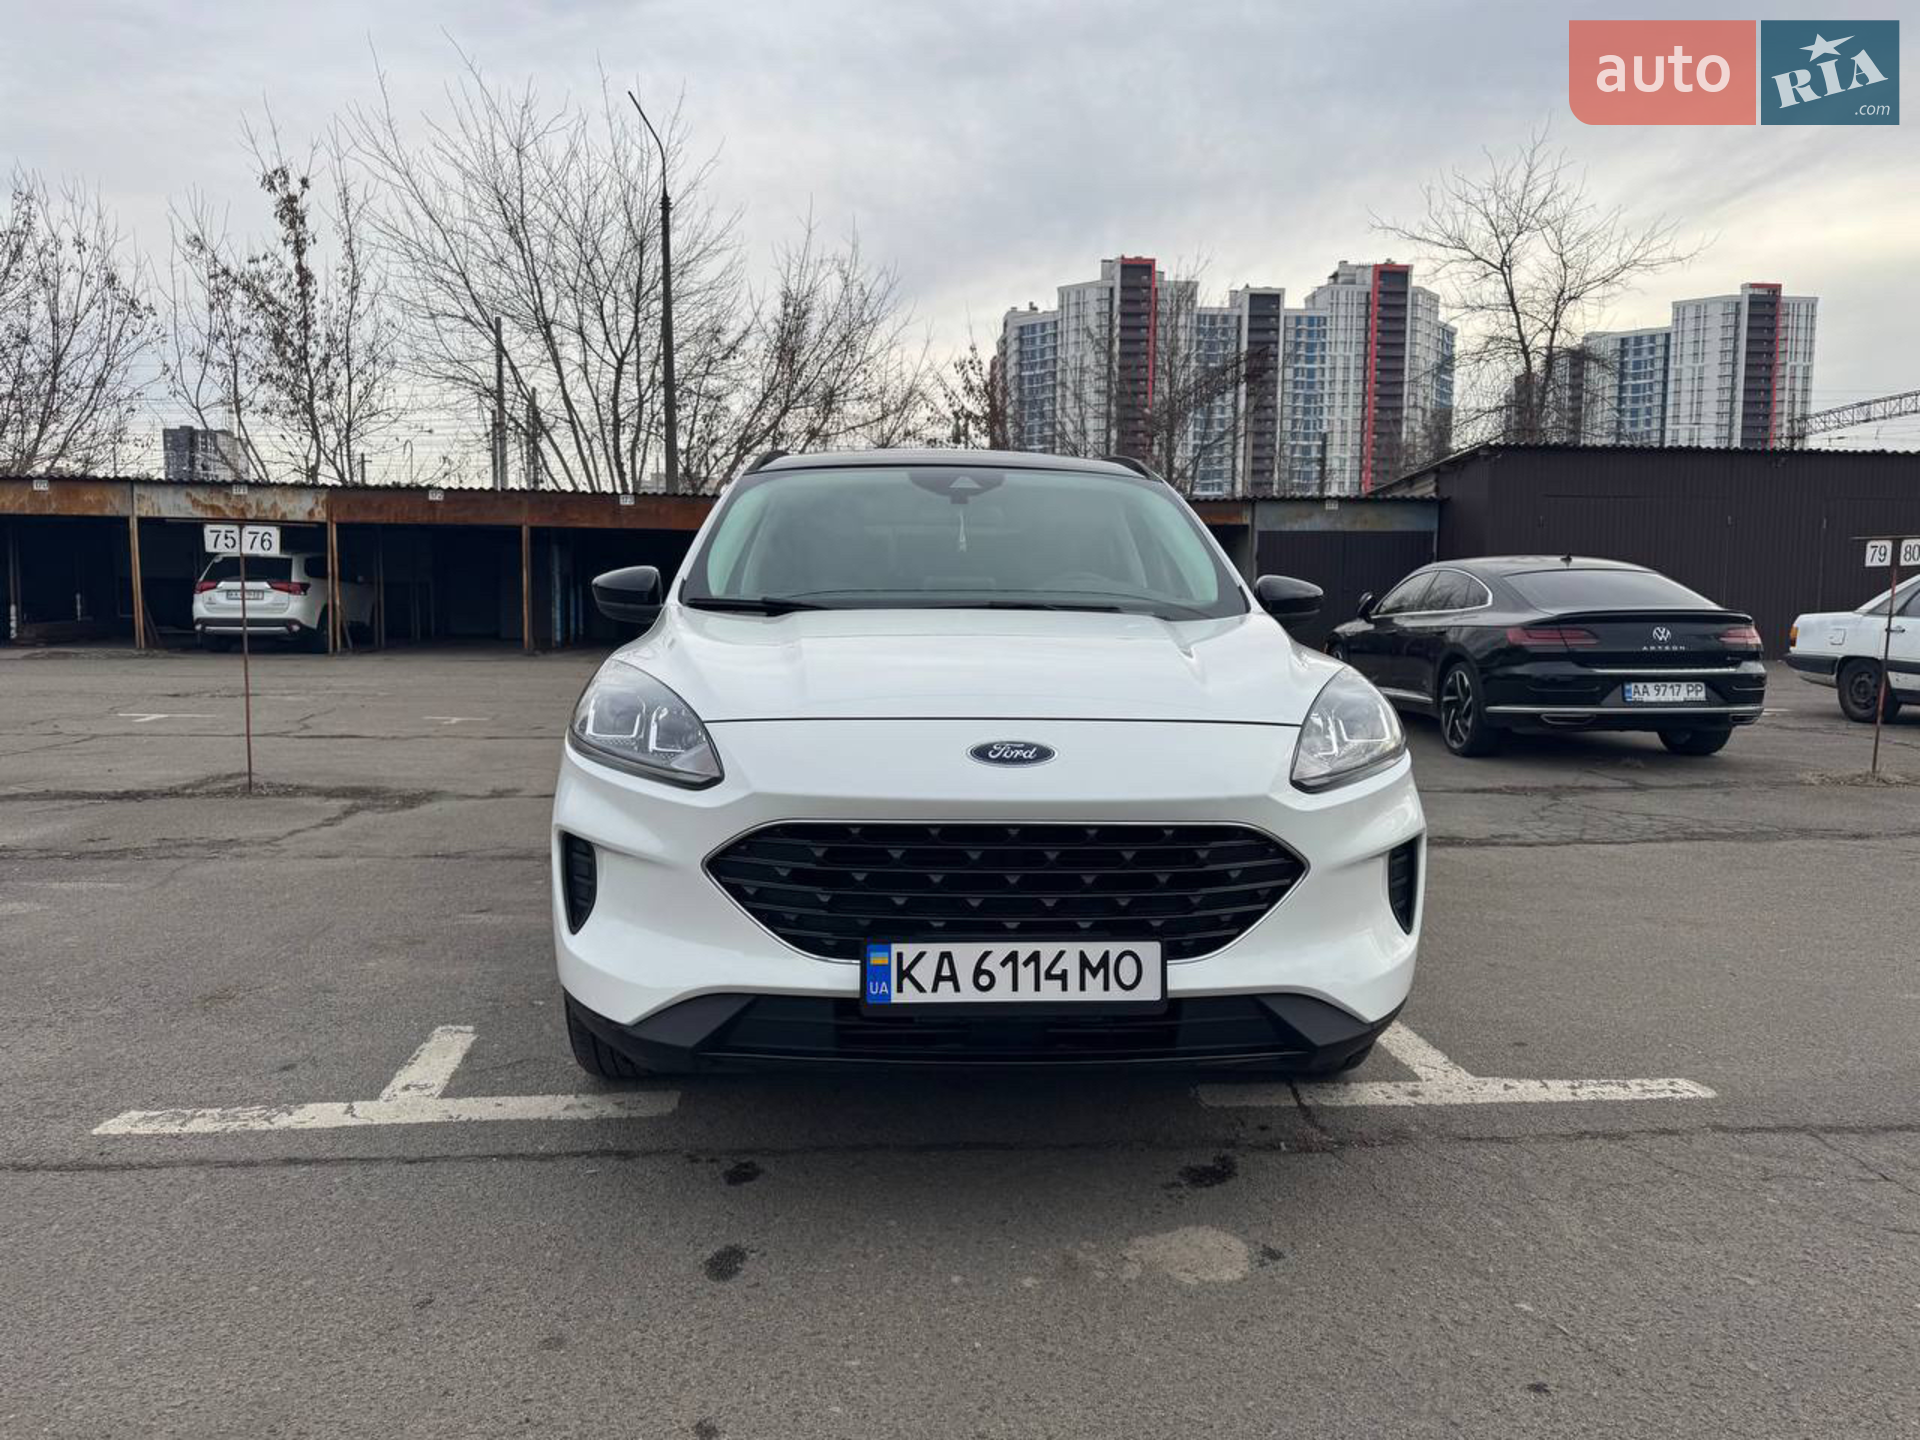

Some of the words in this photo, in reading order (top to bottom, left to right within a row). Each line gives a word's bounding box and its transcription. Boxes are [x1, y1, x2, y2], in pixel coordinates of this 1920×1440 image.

[209, 529, 237, 550] 75
[247, 531, 273, 552] 76
[1870, 544, 1888, 563] 79
[1903, 544, 1920, 562] 80
[1632, 683, 1651, 697] AA
[1653, 683, 1682, 697] 9717
[1686, 683, 1704, 697] PP
[987, 743, 1038, 760] Ford
[895, 950, 961, 993] KA
[971, 950, 1069, 993] 6114
[1078, 949, 1143, 992] MO
[869, 982, 889, 995] UA
